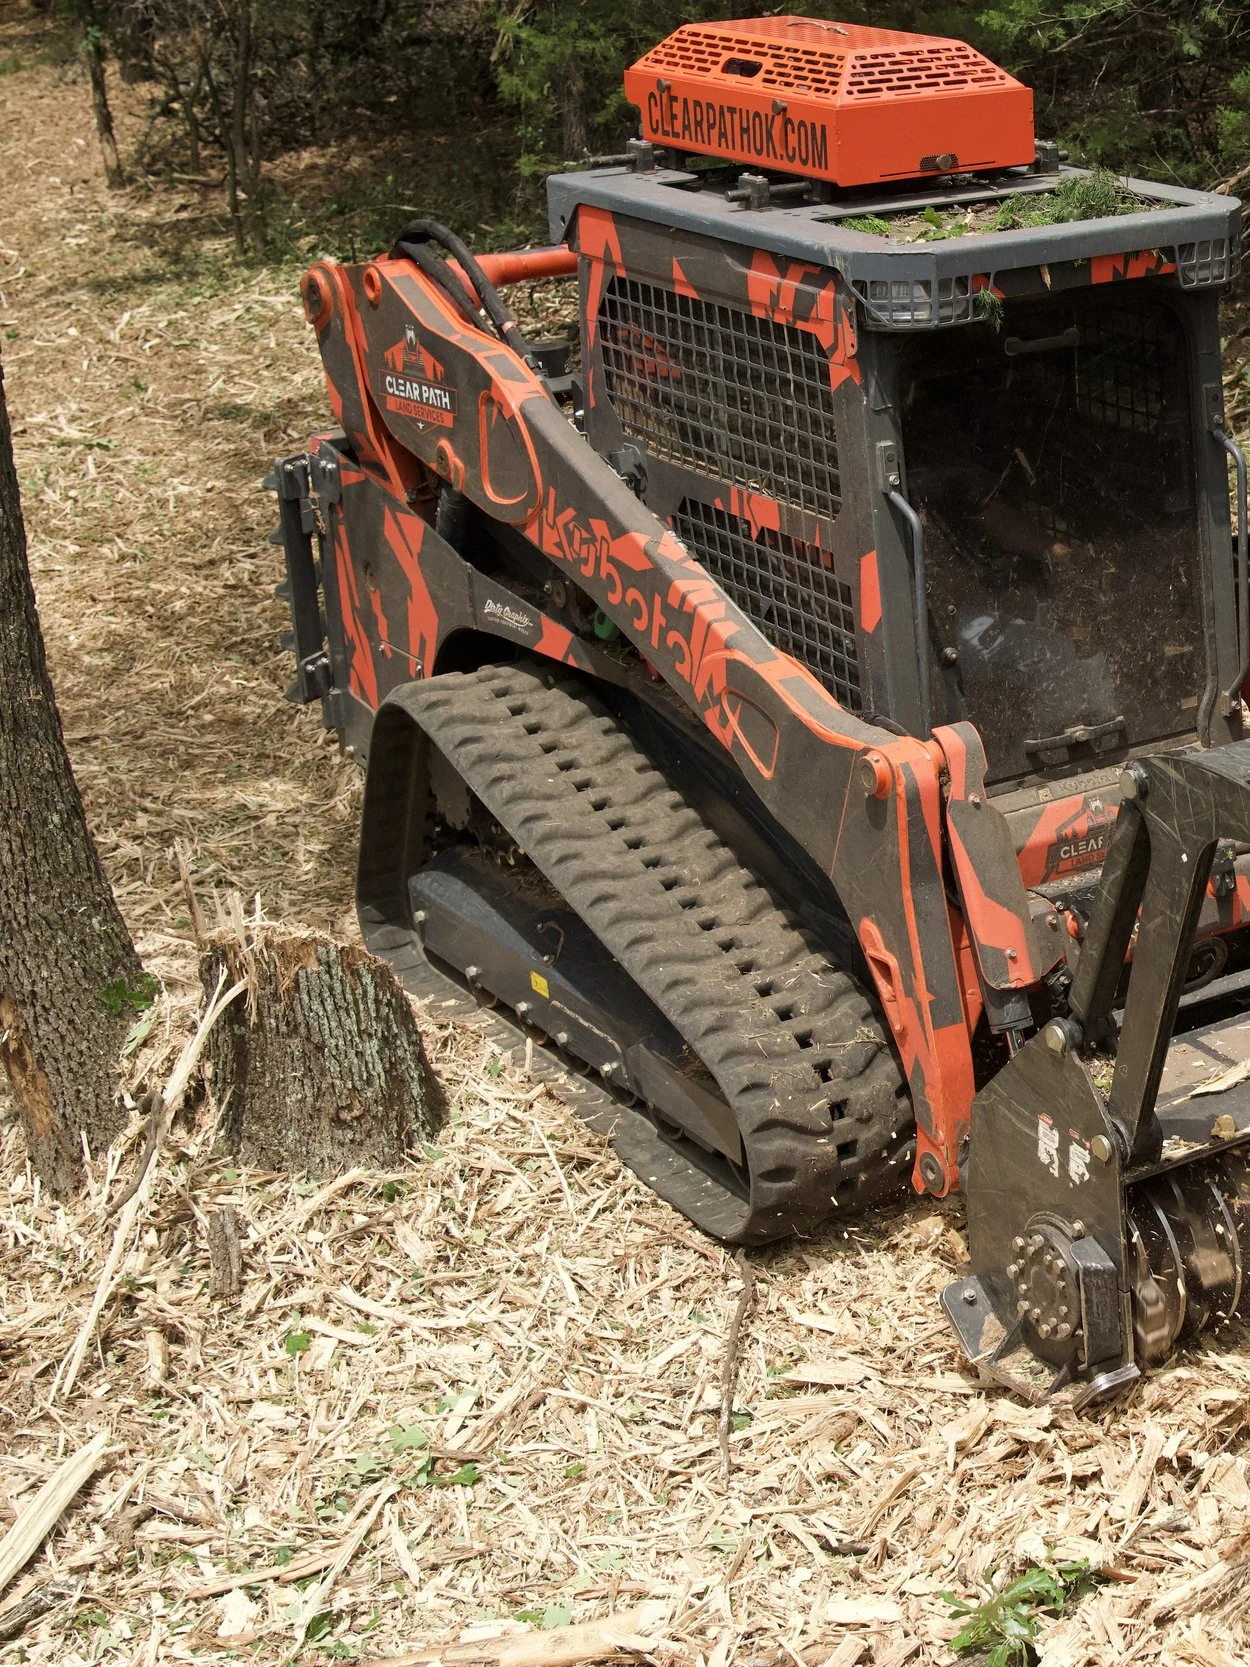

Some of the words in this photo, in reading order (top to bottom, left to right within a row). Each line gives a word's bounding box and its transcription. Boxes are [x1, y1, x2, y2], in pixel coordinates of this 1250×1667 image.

[648, 91, 829, 171] CLEARPATHOK.COM
[385, 375, 421, 402] CLEAR
[421, 385, 451, 410] PATH
[395, 399, 413, 415] LAND
[413, 404, 445, 424] SERVICES
